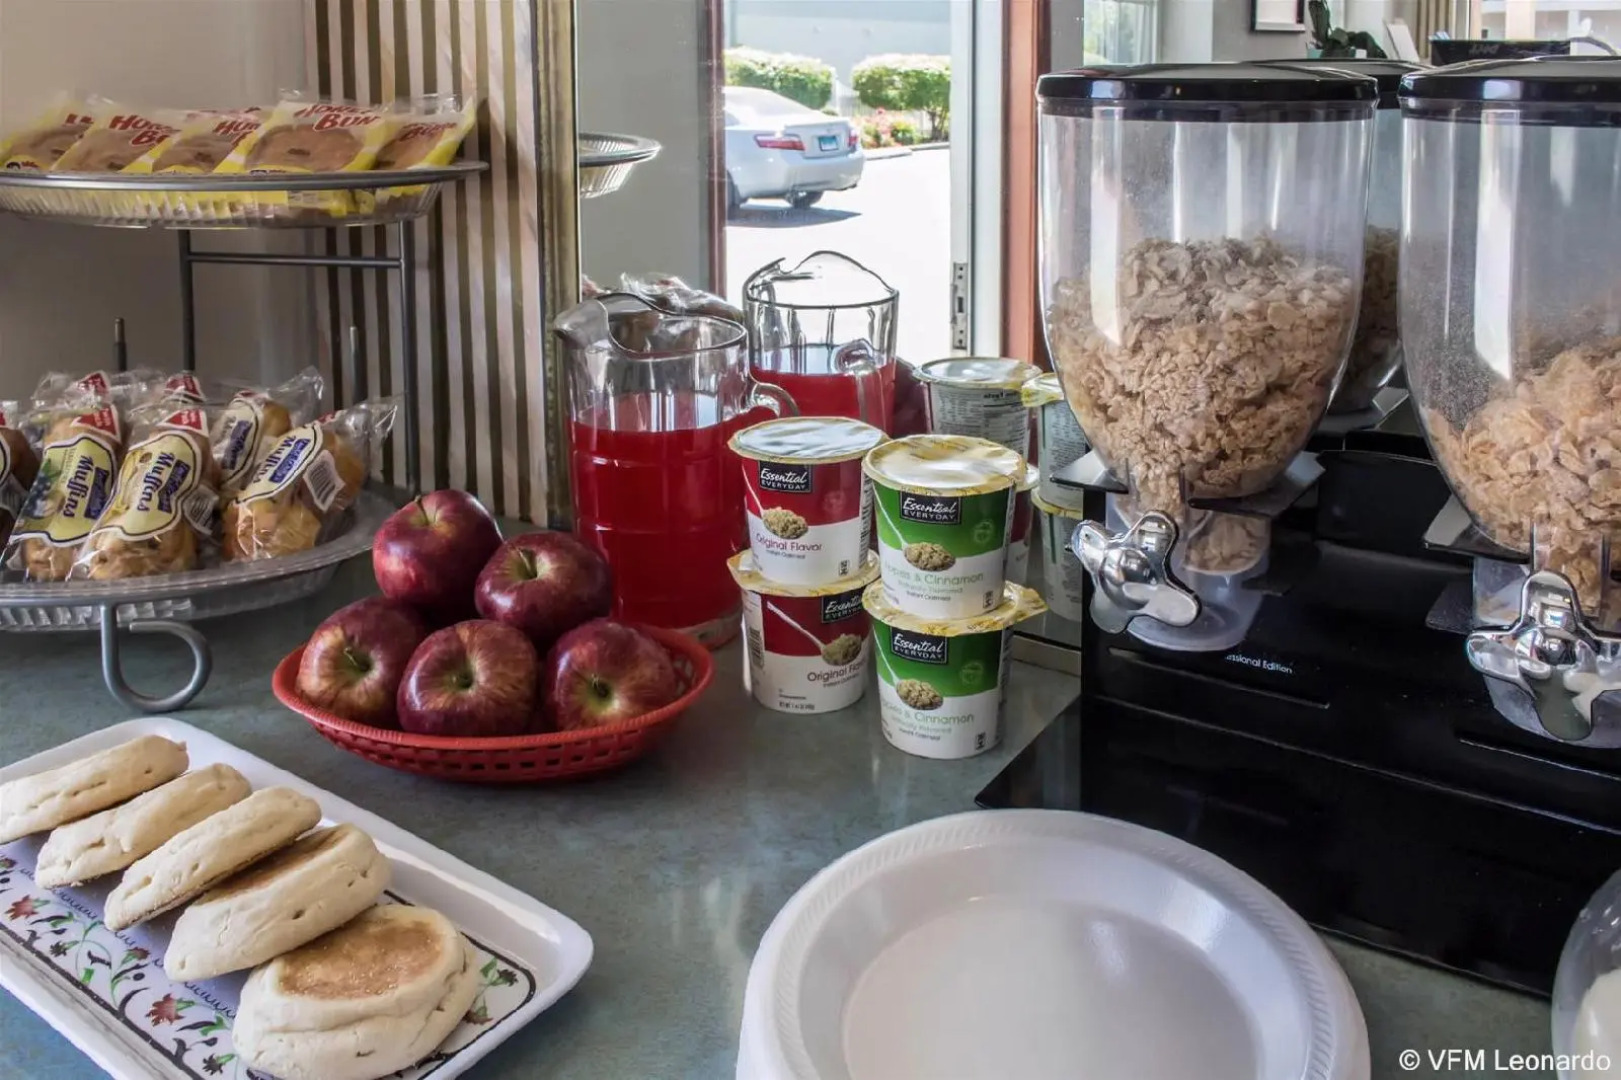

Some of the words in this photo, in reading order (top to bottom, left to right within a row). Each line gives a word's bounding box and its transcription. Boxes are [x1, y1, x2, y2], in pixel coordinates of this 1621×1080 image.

[314, 113, 382, 131] BUN
[137, 452, 175, 511] Muffins
[760, 467, 808, 484] Essential
[63, 455, 94, 518] Muffins
[761, 480, 806, 490] EVERYDAY
[902, 497, 957, 514] Essential
[904, 509, 955, 520] EVERYDAY
[791, 541, 822, 552] Flavor
[924, 572, 983, 585] Cinnamon
[893, 633, 943, 652] Essential
[894, 646, 942, 659] EVERYDAY
[1263, 660, 1293, 674] Edition
[807, 667, 847, 682] Original
[915, 711, 974, 725] Cinnamon
